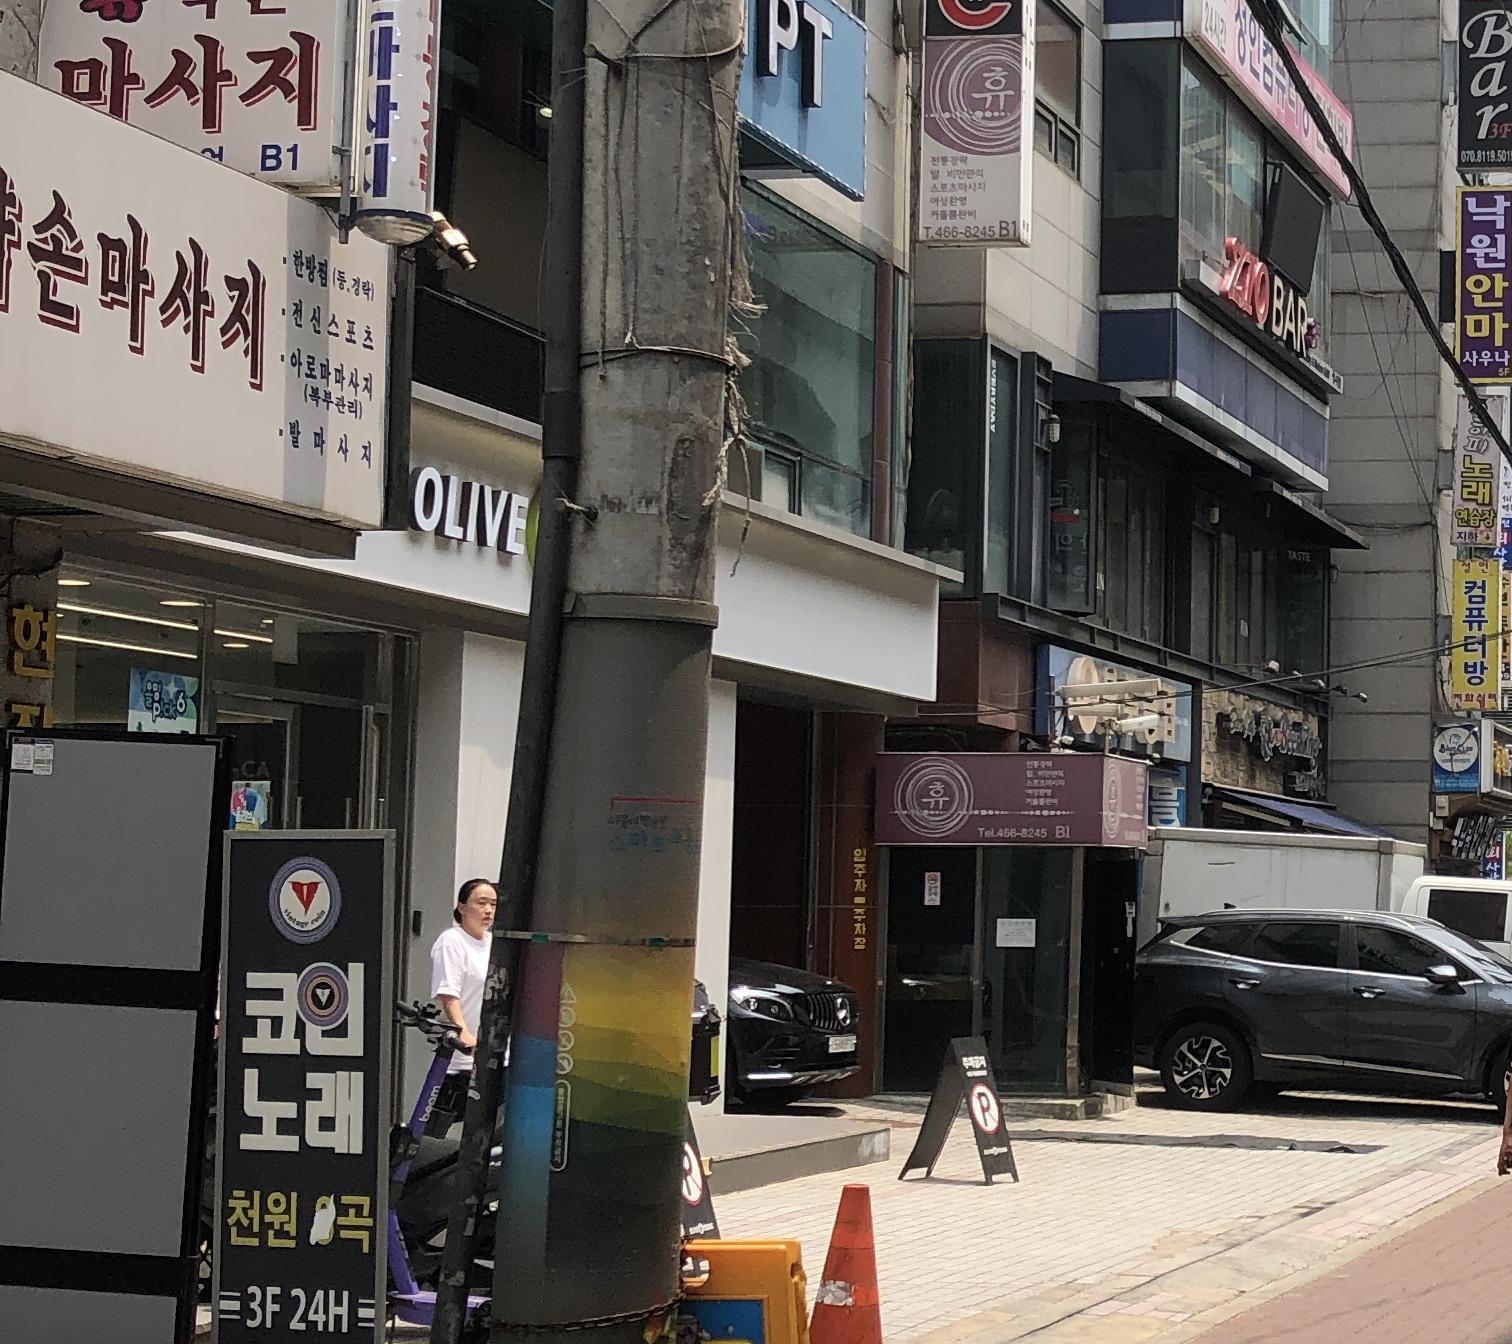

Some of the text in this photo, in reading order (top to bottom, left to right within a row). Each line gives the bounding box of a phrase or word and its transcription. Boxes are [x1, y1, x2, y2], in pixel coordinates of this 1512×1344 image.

[54, 31, 321, 134] 마사지
[972, 66, 1014, 109] 휴
[260, 143, 299, 171] B1
[999, 220, 1018, 238] B1
[1272, 274, 1307, 358] BAR
[1463, 350, 1510, 367] 사우나
[1461, 454, 1493, 506] 노래
[413, 467, 528, 555] OLIVE
[1455, 508, 1496, 528] 연습장
[1462, 579, 1489, 687] 컴퓨터방
[920, 780, 951, 814] 휴
[242, 962, 364, 1056] 코인
[240, 1068, 364, 1154] 노래
[227, 1189, 299, 1248] 천원
[246, 1287, 350, 1333] 3F 24H
